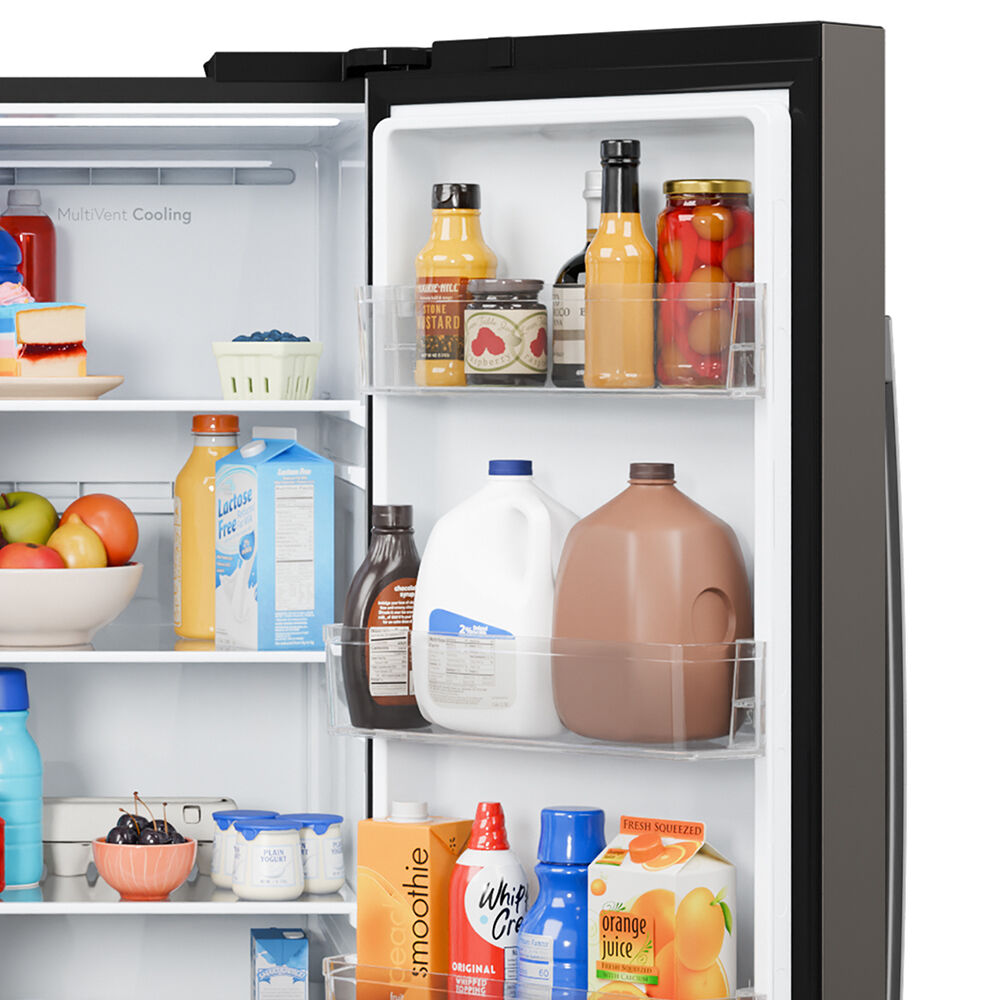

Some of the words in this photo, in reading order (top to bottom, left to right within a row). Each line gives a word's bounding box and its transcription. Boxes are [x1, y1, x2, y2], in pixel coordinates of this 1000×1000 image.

[57, 206, 128, 221] MultiVent
[132, 207, 192, 225] Cooling
[218, 487, 253, 518] Lactose
[218, 518, 237, 540] Free
[622, 818, 653, 832] FRESH
[654, 821, 702, 837] SQUEEZED
[260, 855, 288, 864] YOGURT
[263, 849, 285, 857] PLAIN
[402, 847, 429, 978] smoothie
[601, 912, 648, 935] orange
[601, 932, 634, 960] juice
[451, 961, 497, 975] ORIGINAL
[455, 984, 487, 994] TOPPING
